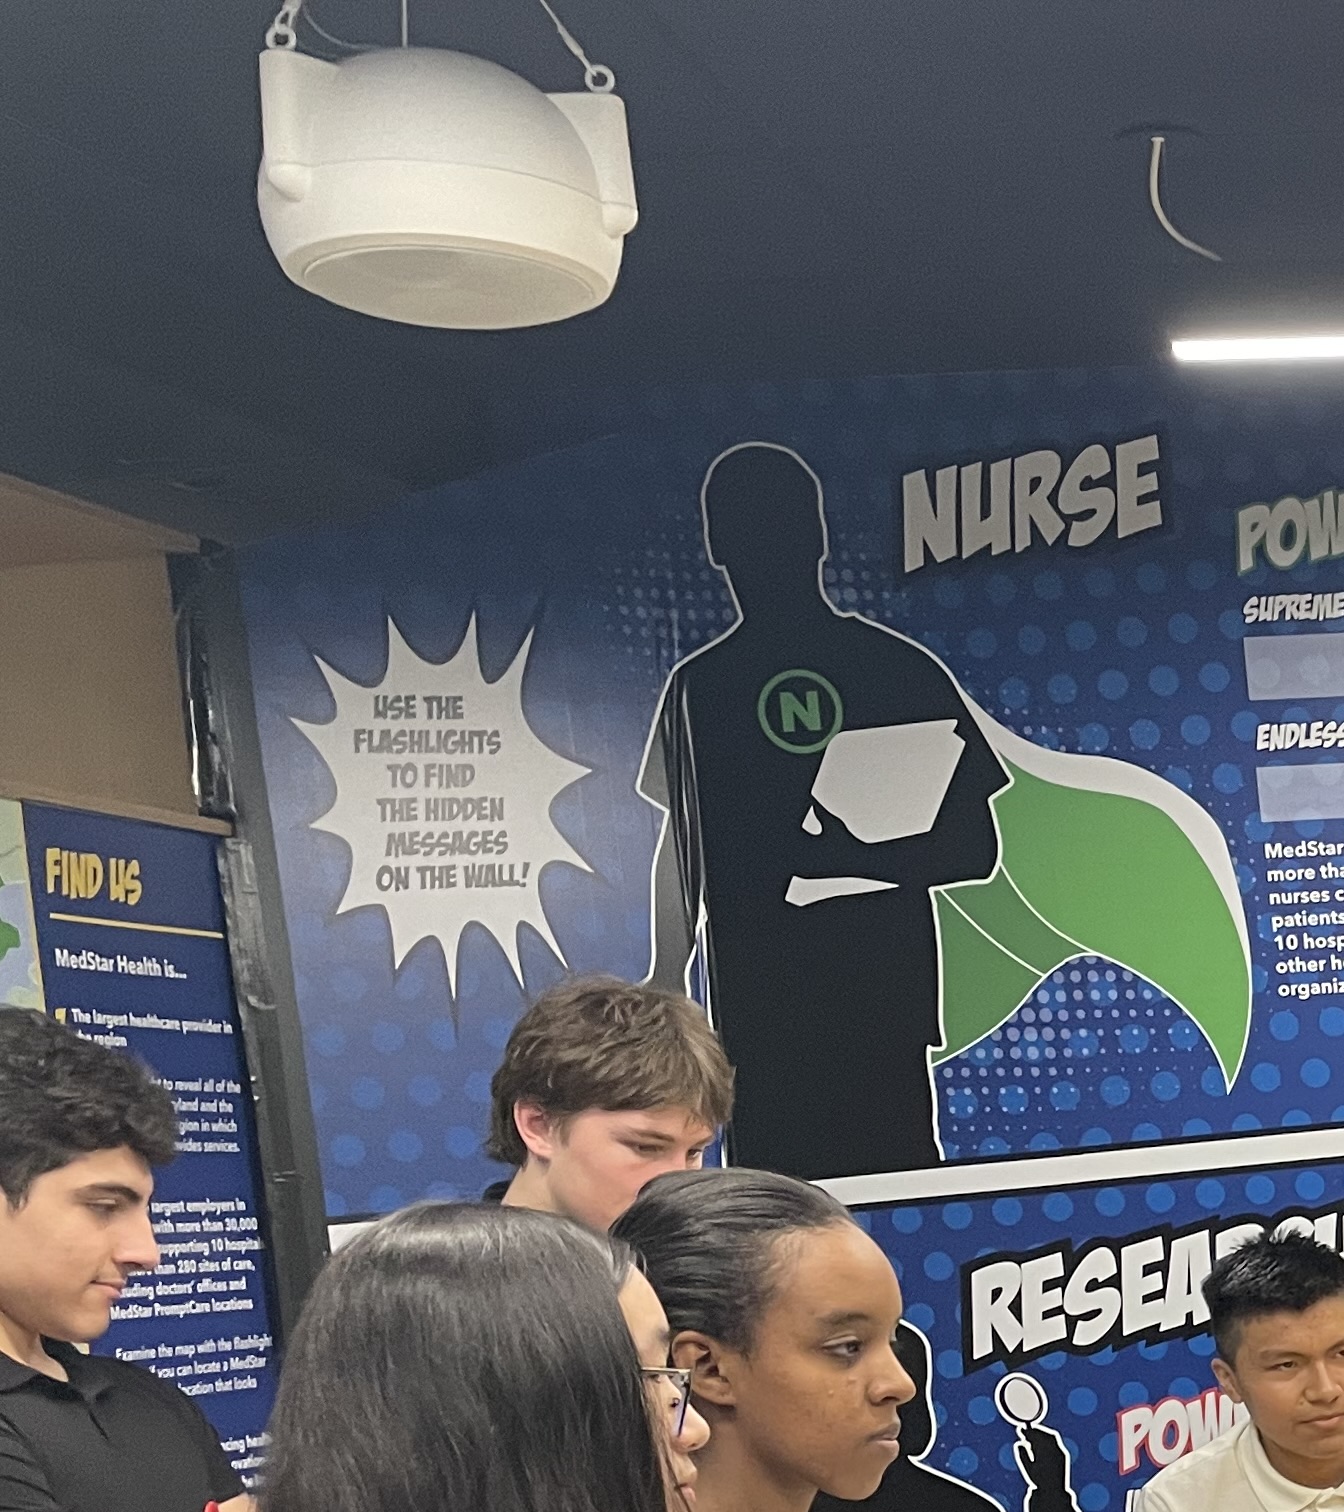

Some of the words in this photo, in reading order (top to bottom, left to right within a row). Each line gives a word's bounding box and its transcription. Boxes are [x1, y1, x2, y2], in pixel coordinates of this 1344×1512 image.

[903, 434, 1163, 573] NURSE
[1242, 591, 1344, 624] SUPREME
[373, 694, 417, 720] USE
[423, 696, 464, 720] THE
[779, 690, 821, 732] N
[353, 729, 502, 755] FLASHLIGHTS
[386, 762, 418, 789] TO
[423, 763, 476, 789] FIND
[376, 797, 418, 822] THE
[425, 796, 504, 822] HIDDEN
[385, 830, 509, 858] MESSAGES
[1264, 839, 1344, 859] MedStar
[45, 847, 104, 899] FIND
[109, 857, 143, 906] US
[376, 865, 410, 892] ON
[416, 864, 457, 889] THE
[463, 862, 531, 888] WALL!
[1266, 865, 1315, 883] more
[1268, 888, 1332, 906] nurses
[1273, 935, 1298, 951] 10
[54, 947, 115, 973] MedStar
[116, 955, 162, 977] Health
[163, 959, 188, 980] is...
[1275, 954, 1327, 975] other
[71, 1008, 91, 1023] The
[93, 1009, 128, 1028] largest
[129, 1012, 180, 1030] healthcare
[181, 1019, 222, 1034] provider
[222, 1020, 233, 1034] in
[187, 1198, 235, 1216] employers
[235, 1197, 247, 1212] in
[175, 1221, 201, 1233] more
[201, 1218, 224, 1233] than
[224, 1217, 259, 1233] 30,000
[211, 1238, 224, 1253] 10
[178, 1259, 197, 1273] 280
[198, 1258, 221, 1273] sites
[222, 1256, 231, 1271] of
[232, 1259, 257, 1272] care,
[196, 1278, 228, 1293] offices
[229, 1276, 247, 1291] and
[110, 1304, 153, 1320] MedStar
[154, 1300, 211, 1319] PromptCare
[212, 1297, 253, 1312] locations
[115, 1346, 156, 1361] Examine
[157, 1343, 173, 1358] the
[174, 1345, 195, 1359] map
[197, 1339, 216, 1354] with
[217, 1338, 232, 1352] the
[177, 1365, 193, 1377] can
[194, 1361, 221, 1374] locate
[229, 1354, 266, 1371] MedStar
